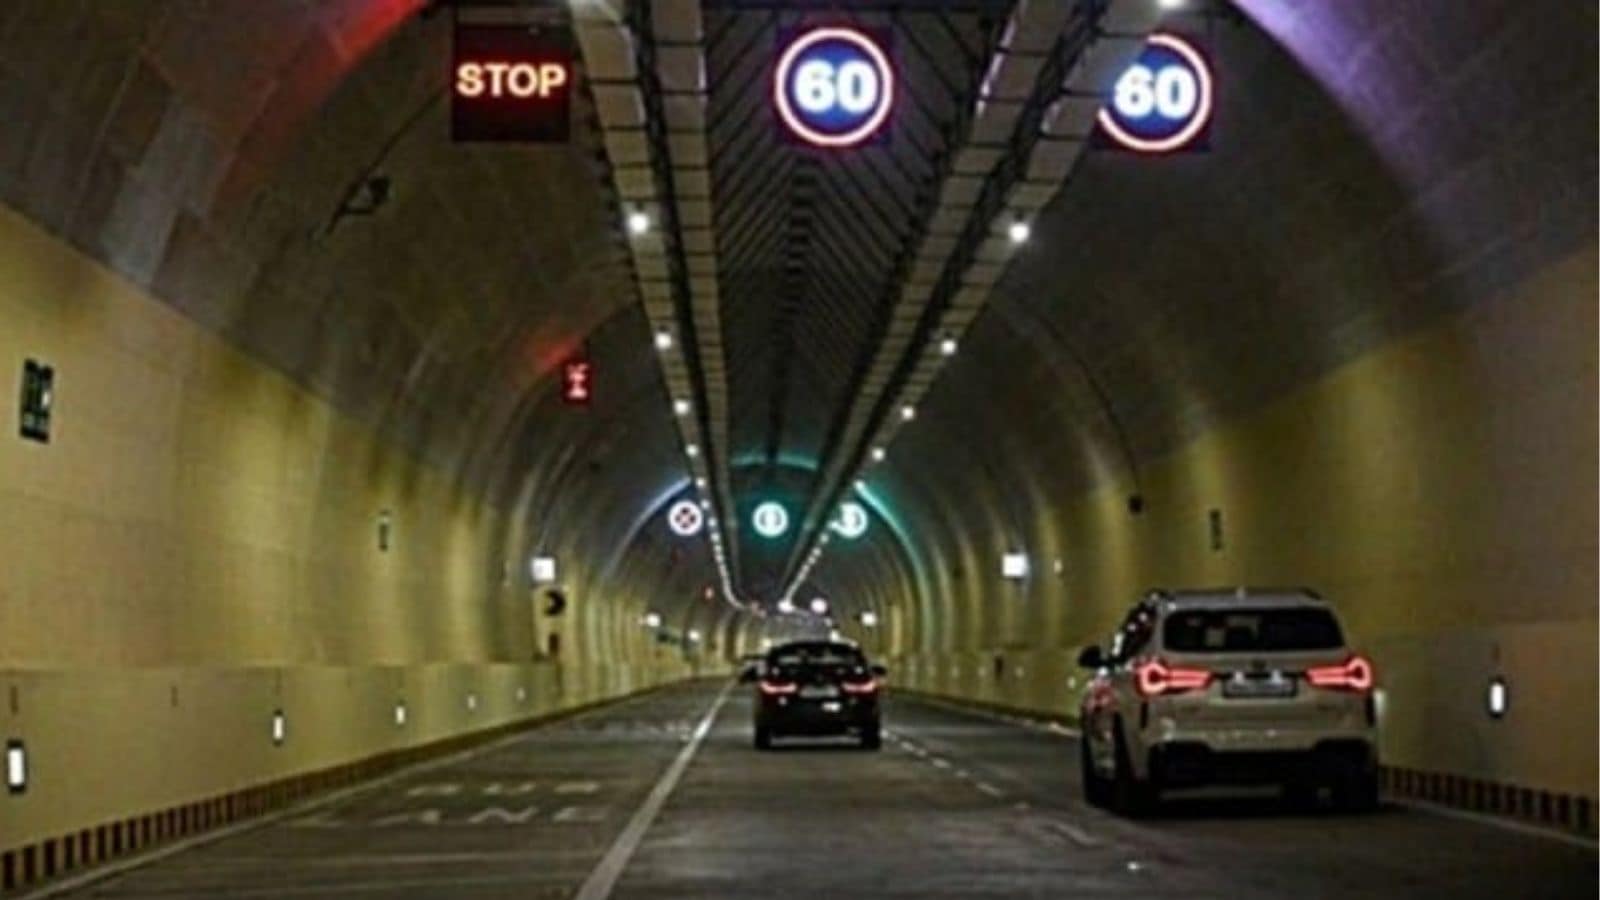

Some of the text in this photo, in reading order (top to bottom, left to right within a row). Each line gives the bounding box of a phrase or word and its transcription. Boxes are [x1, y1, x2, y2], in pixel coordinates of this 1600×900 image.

[456, 62, 567, 97] STOP
[795, 60, 878, 113] 60
[1114, 64, 1197, 118] 60
